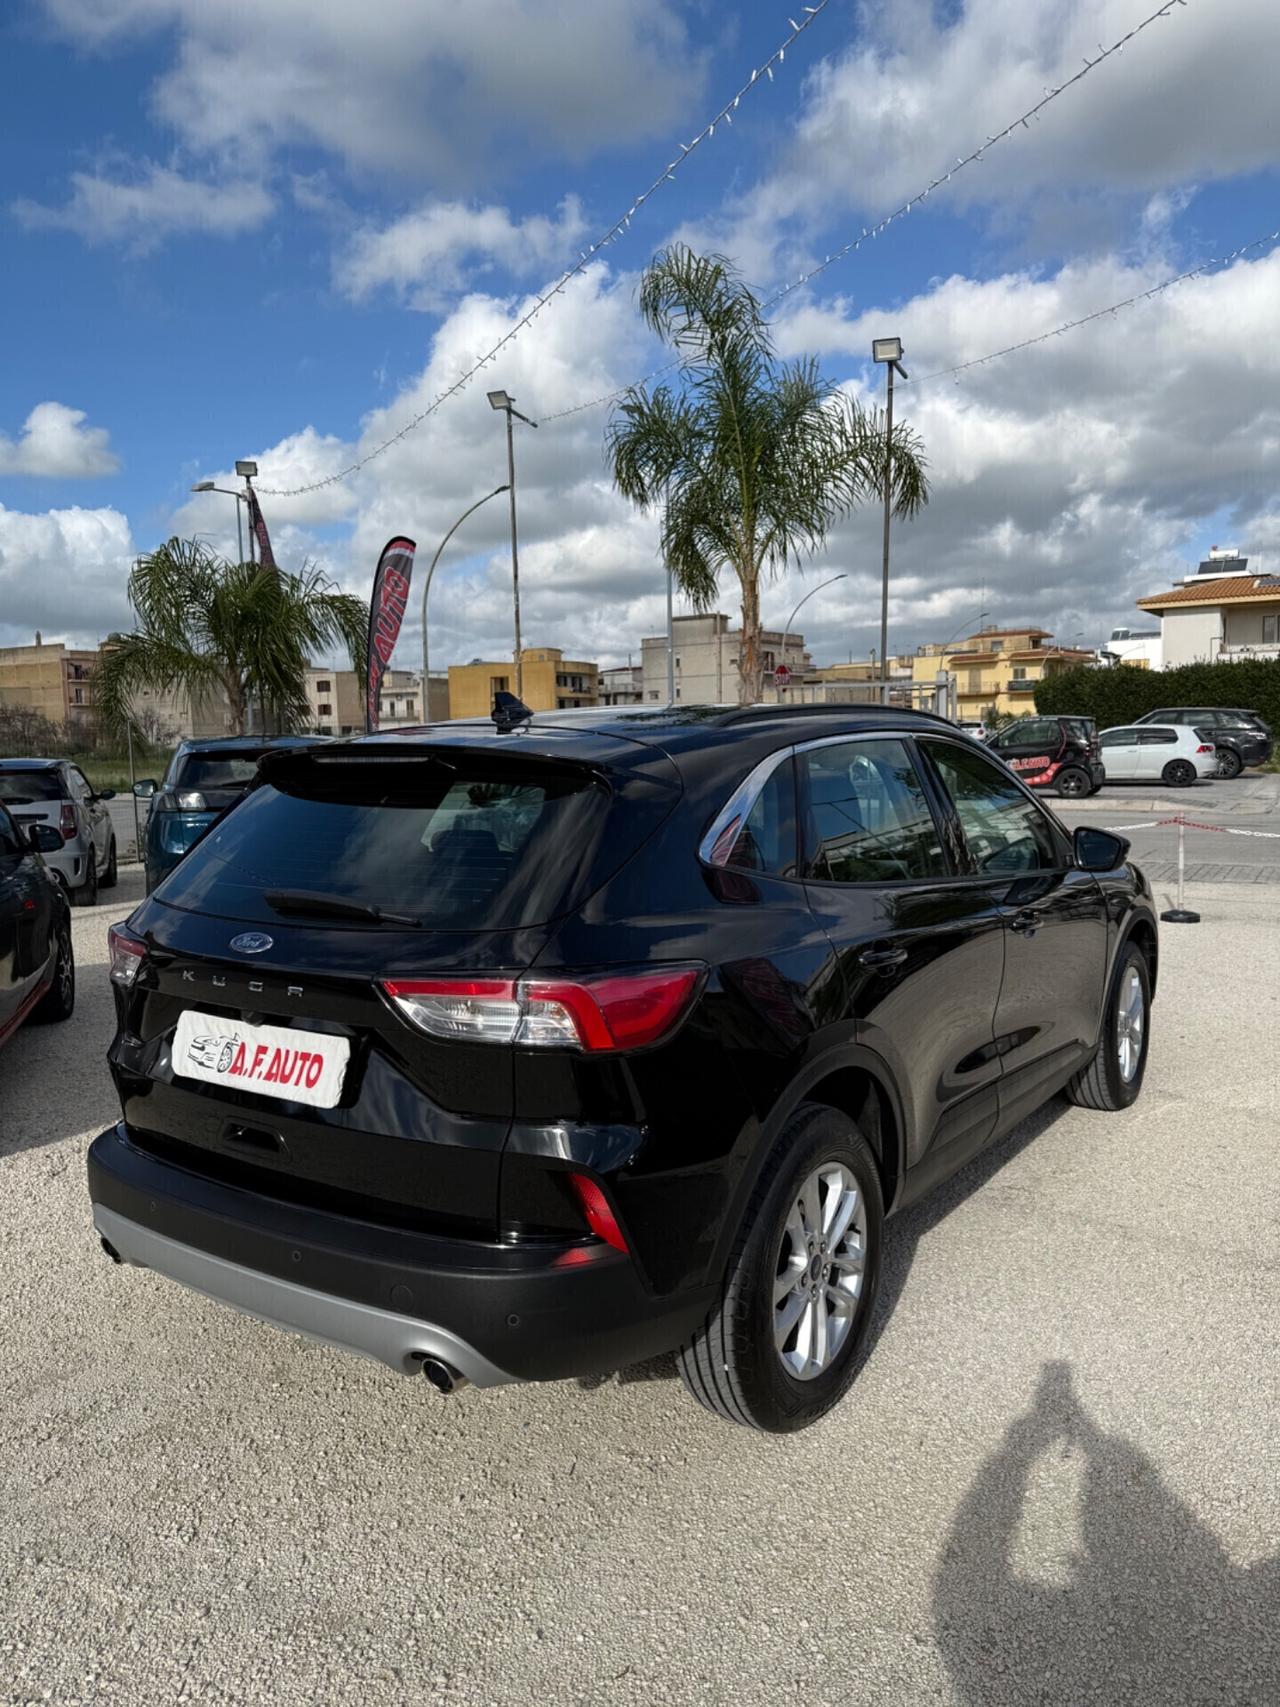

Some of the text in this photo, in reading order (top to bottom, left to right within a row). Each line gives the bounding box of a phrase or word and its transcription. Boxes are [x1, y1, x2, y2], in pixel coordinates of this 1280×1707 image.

[374, 566, 410, 665] AUTO
[182, 970, 304, 997] KUGA
[228, 1041, 324, 1089] A.F.AUTO
